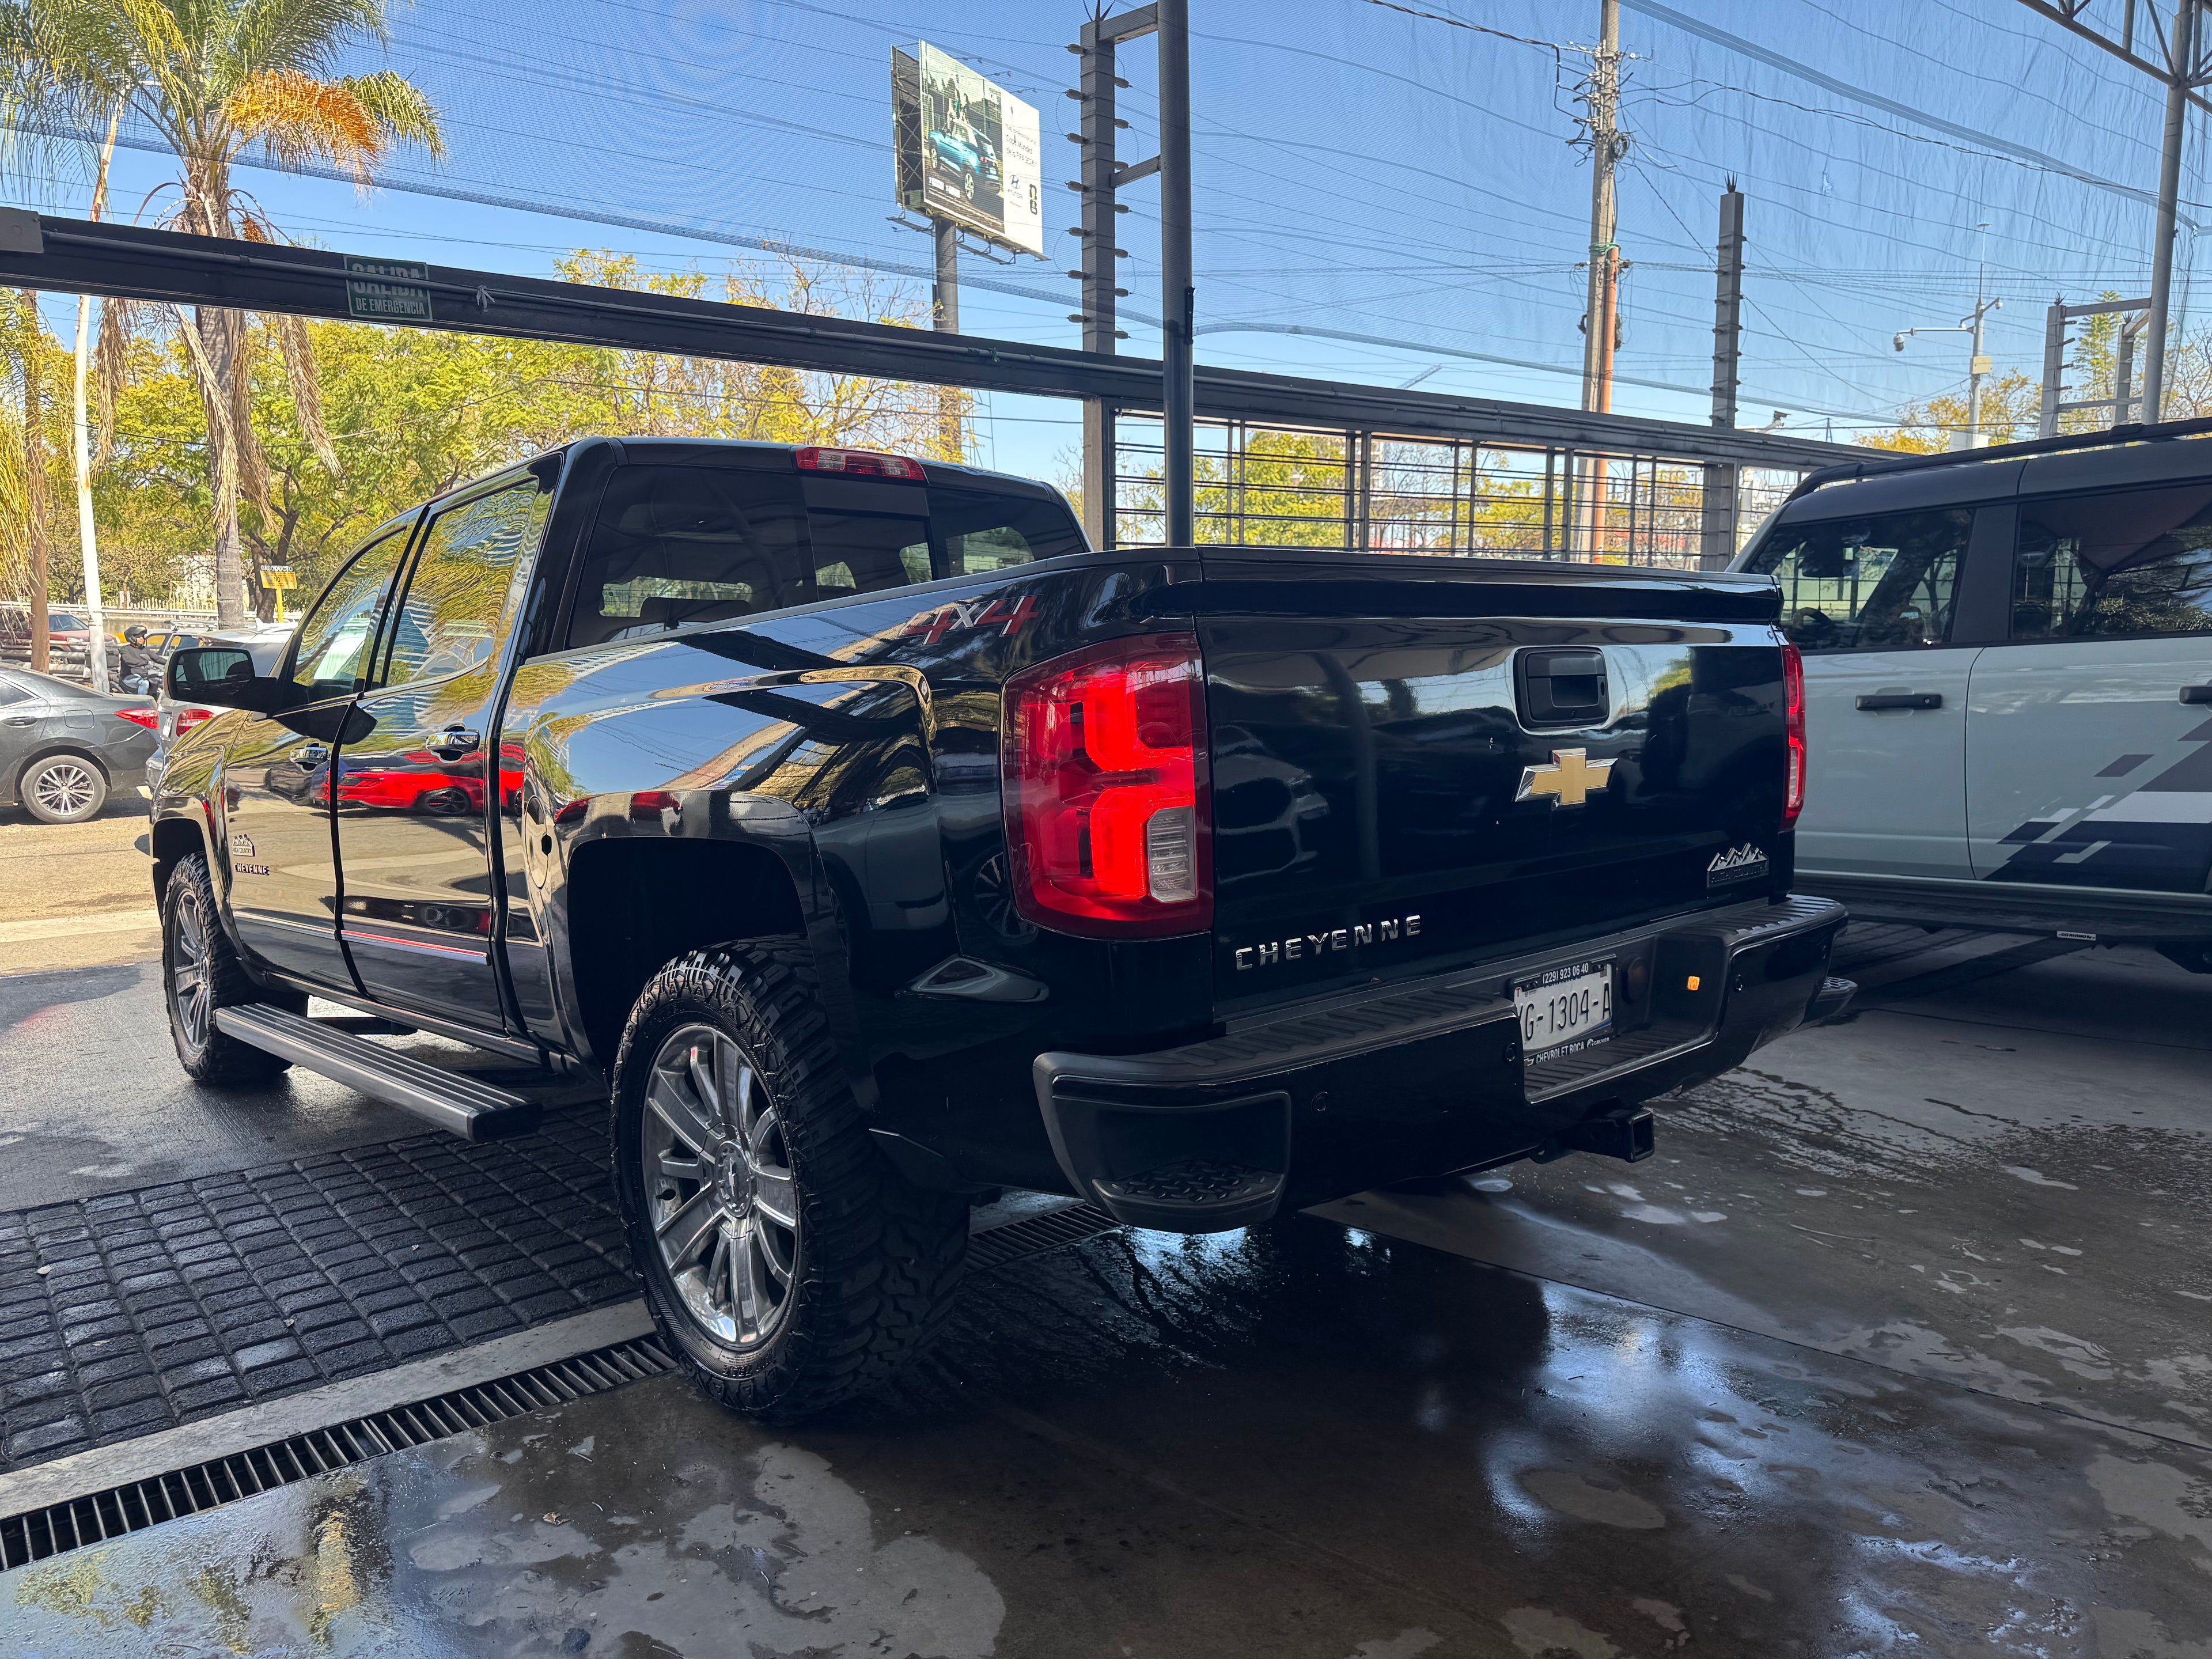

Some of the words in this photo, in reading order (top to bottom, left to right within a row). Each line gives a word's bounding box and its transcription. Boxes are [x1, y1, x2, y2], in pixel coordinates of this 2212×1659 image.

[355, 297, 368, 311] DE
[369, 298, 425, 315] EMERGENCIA
[235, 863, 270, 876] CHEYENNE
[1236, 914, 1421, 971] CHEYENNE
[1543, 972, 1558, 984] (229)
[1560, 967, 1571, 979] 923
[1572, 965, 1580, 976] 06
[1581, 963, 1589, 974] 40
[1536, 1045, 1569, 1065] CHEVROLET
[1569, 1041, 1585, 1054] BOCA
